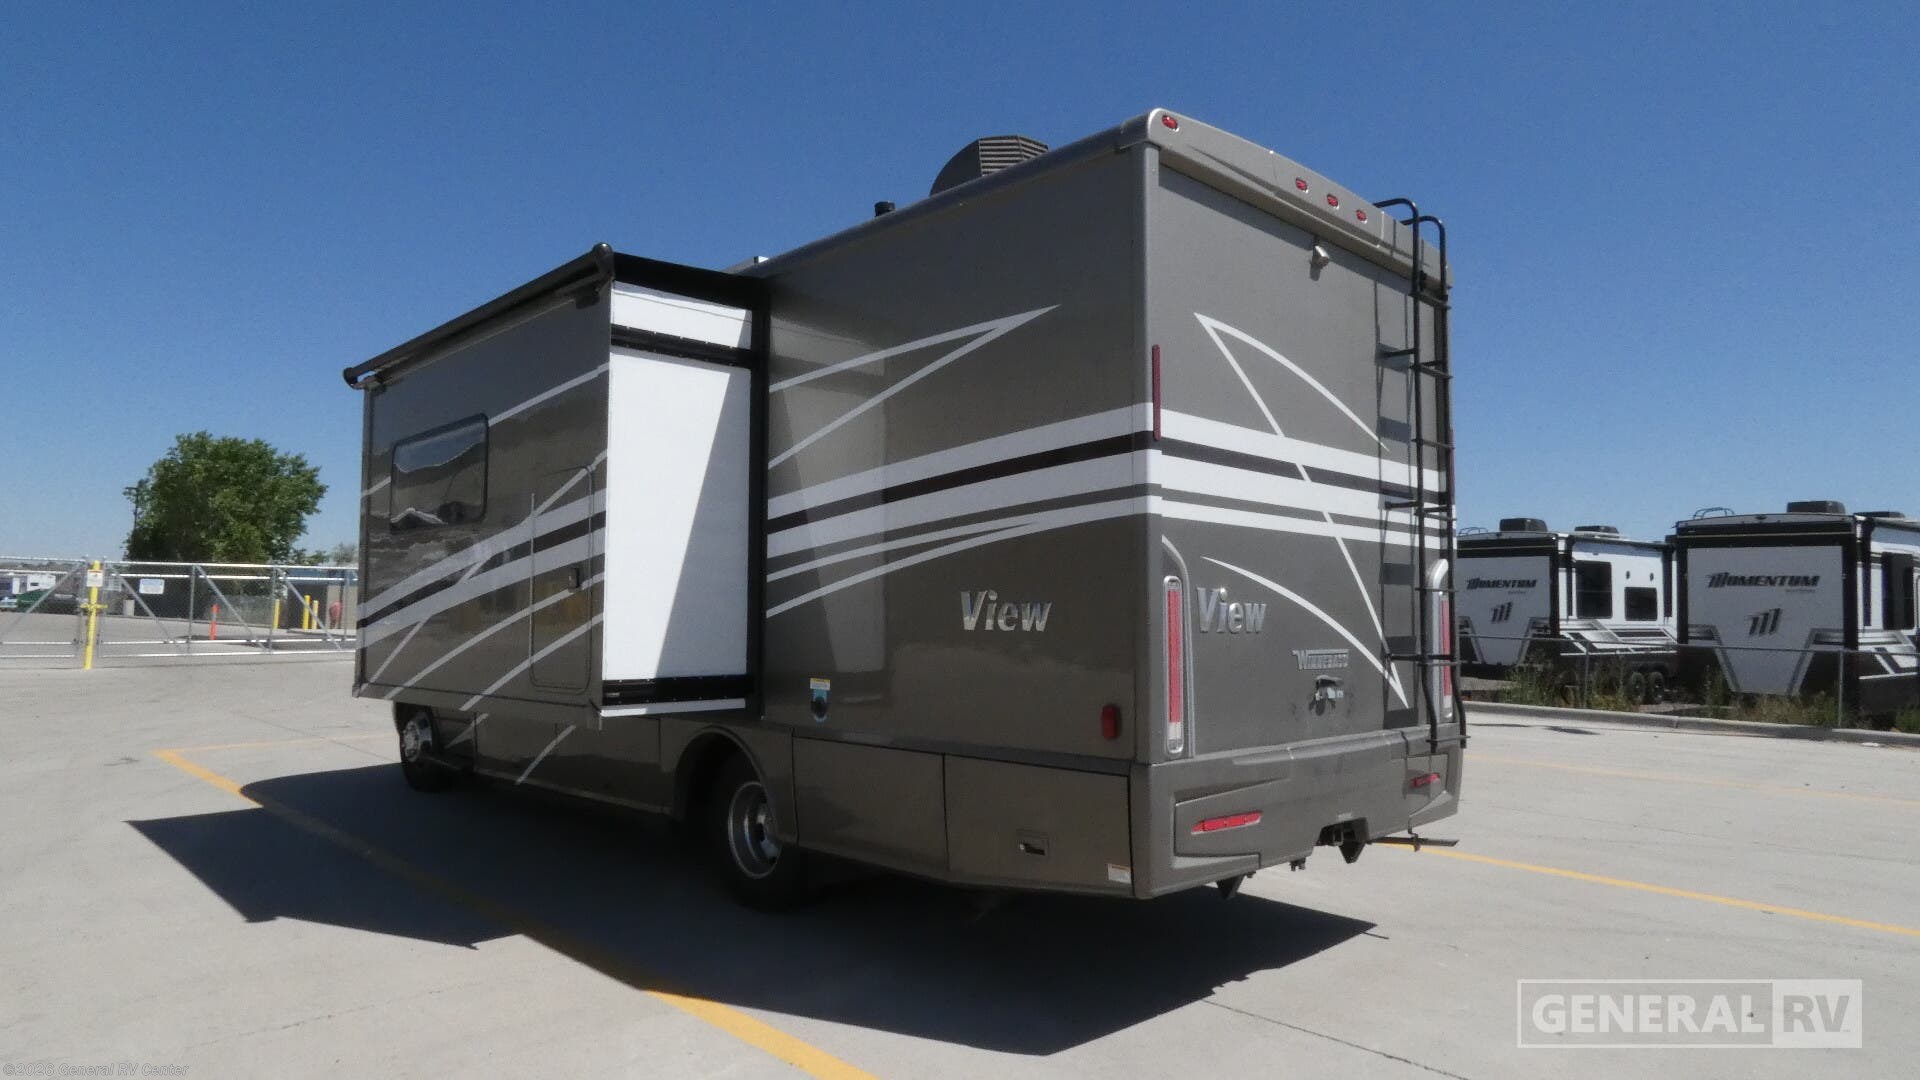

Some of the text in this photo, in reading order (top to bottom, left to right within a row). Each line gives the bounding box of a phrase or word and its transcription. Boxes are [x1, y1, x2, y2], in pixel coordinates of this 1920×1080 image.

[1466, 577, 1538, 590] MOMENTUM
[1706, 572, 1820, 588] MOMENTUM
[960, 589, 1052, 632] View
[1197, 587, 1266, 633] View
